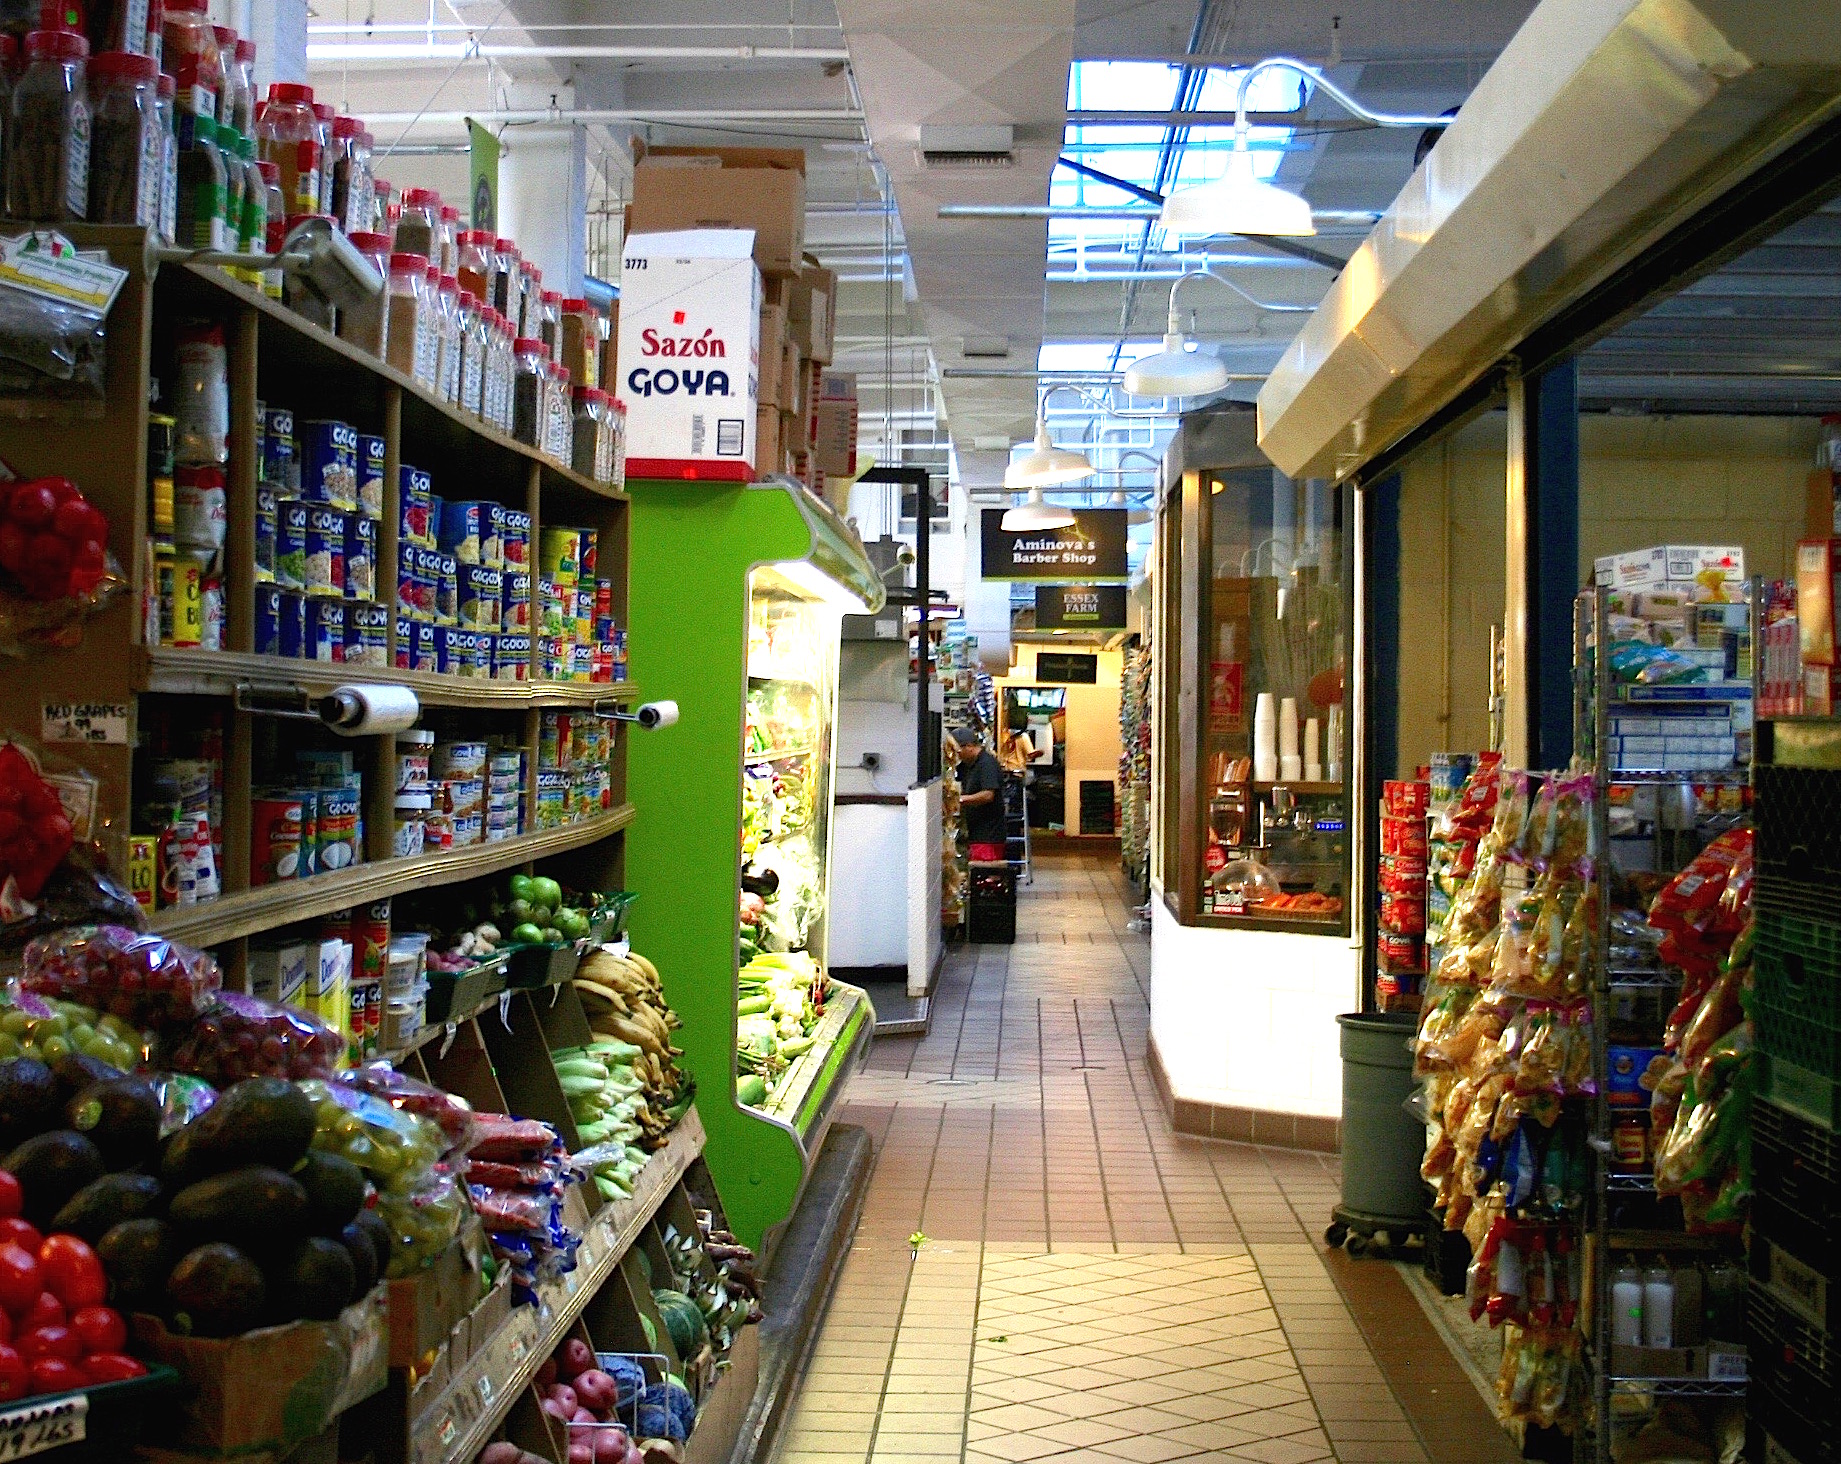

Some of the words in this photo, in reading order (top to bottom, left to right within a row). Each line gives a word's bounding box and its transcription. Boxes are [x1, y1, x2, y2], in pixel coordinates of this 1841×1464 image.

[625, 259, 648, 270] 3773
[641, 328, 727, 358] Sazón
[628, 367, 729, 398] GOYA
[1013, 552, 1059, 563] Barber
[1061, 551, 1097, 565] Shop
[1063, 593, 1099, 603] ESSEX
[1065, 604, 1097, 613] FARM
